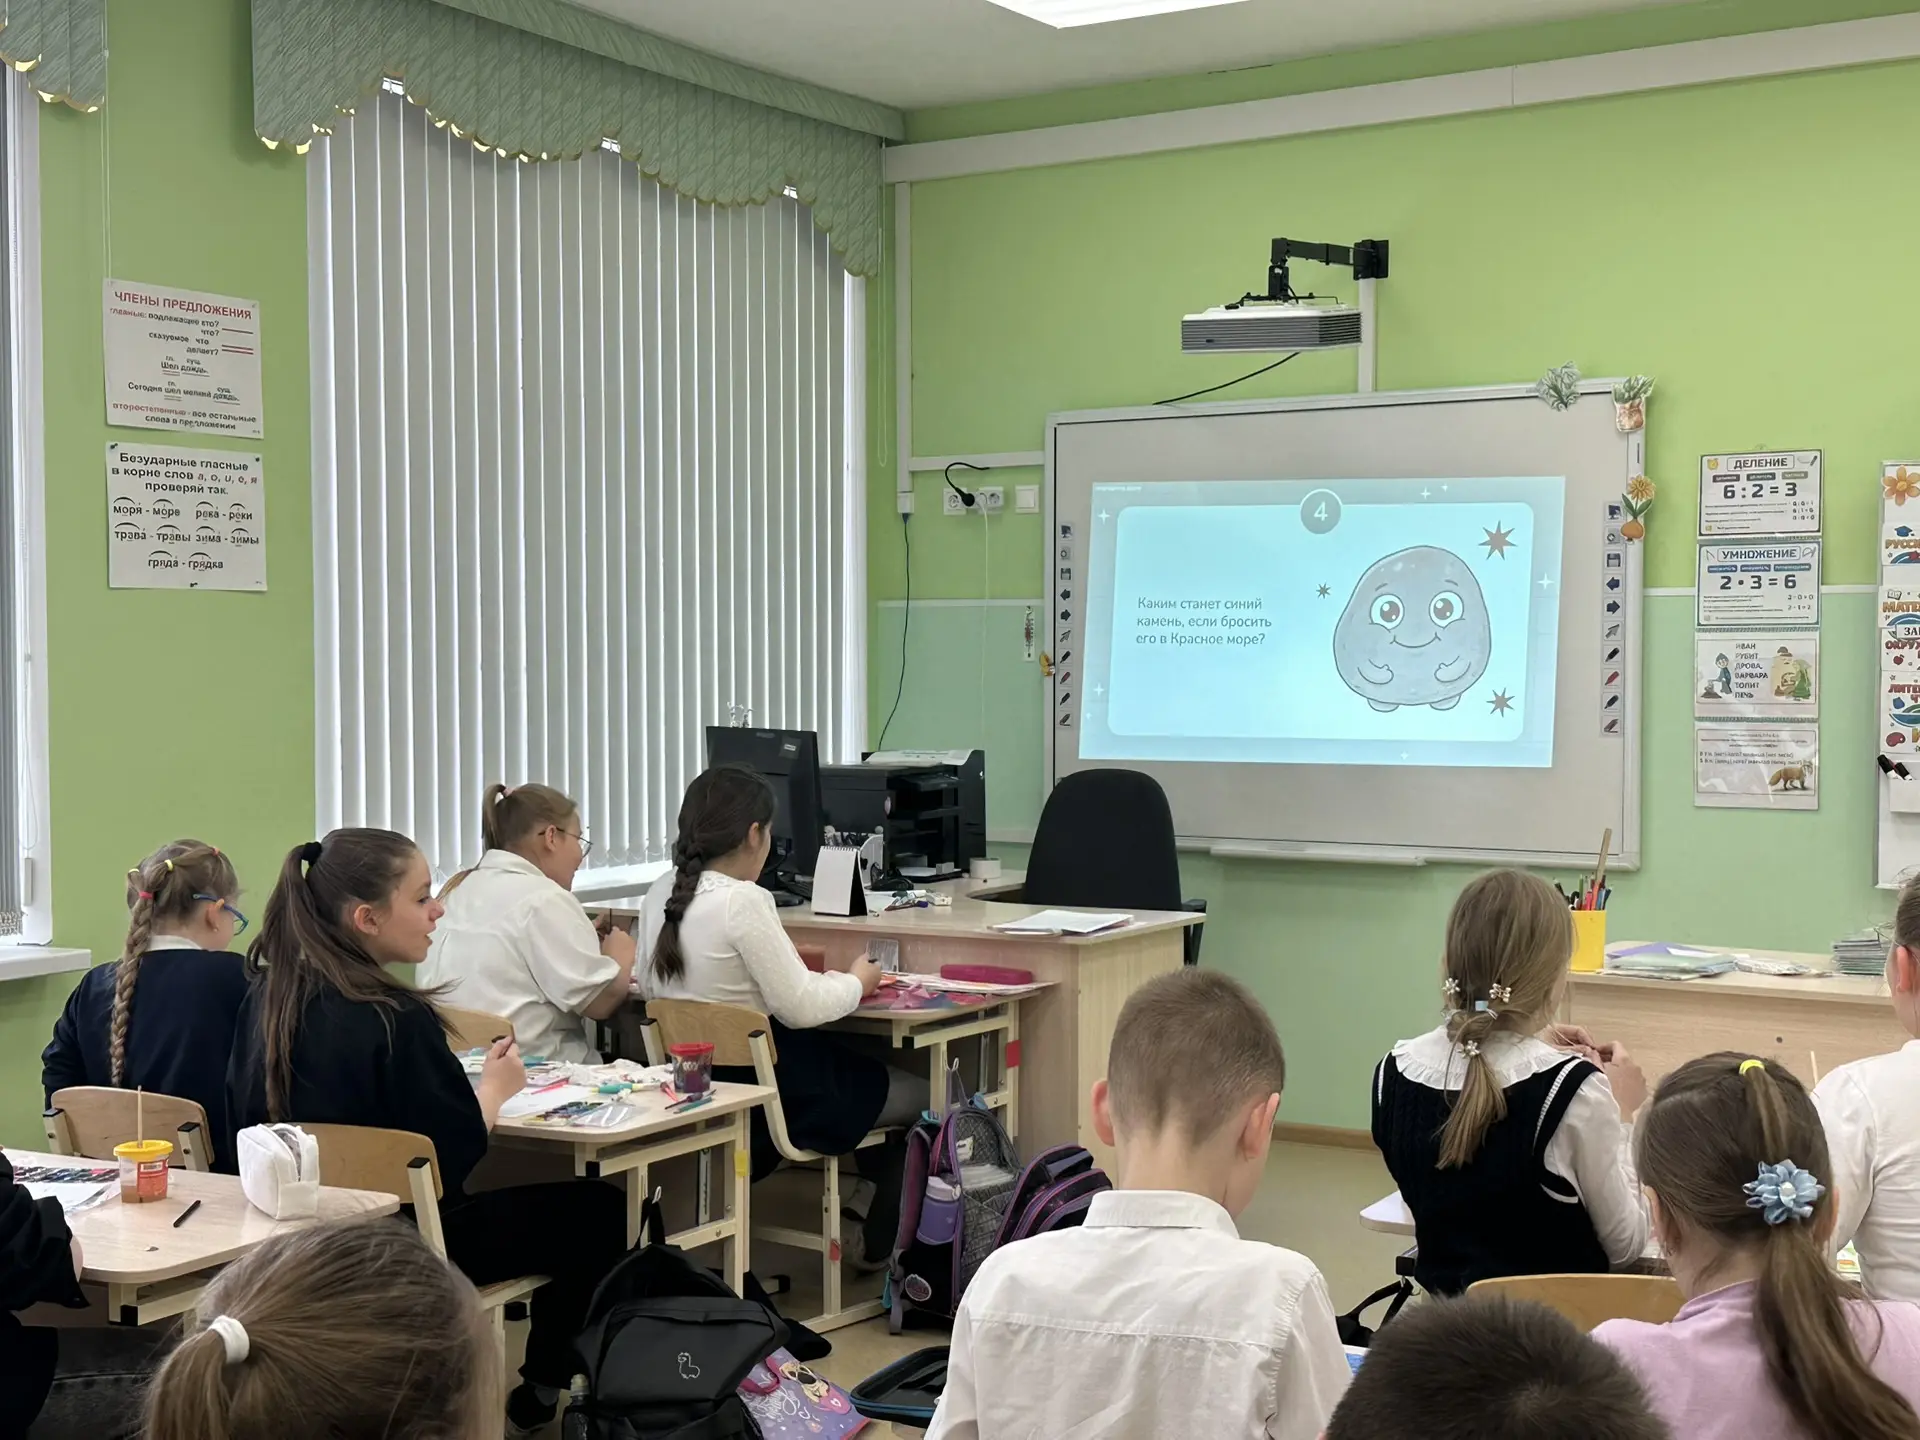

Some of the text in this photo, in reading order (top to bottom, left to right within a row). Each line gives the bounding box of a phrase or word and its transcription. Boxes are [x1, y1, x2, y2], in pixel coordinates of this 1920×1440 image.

[115, 291, 252, 319] ЧЛЕНЫ ПРЕДЛОЖЕНИЯ
[128, 381, 163, 393] Сегодня
[120, 453, 248, 471] Безударные гласные
[1734, 458, 1788, 469] ДЕЛЕНИЕ
[112, 467, 119, 475] в
[124, 467, 160, 479] корне
[164, 470, 194, 480] слов
[145, 482, 228, 495] проверяй так.
[1723, 484, 1736, 499] 6
[1752, 483, 1763, 498] 2
[1785, 482, 1797, 497] 3
[152, 506, 181, 518] море
[1314, 502, 1328, 521] 4
[157, 531, 191, 543] травы
[230, 534, 259, 545] зимы
[1722, 549, 1797, 560] УМНОЖЕНИЕ
[188, 558, 223, 570] грядка
[1720, 575, 1732, 590] 2
[1750, 575, 1762, 589] 3
[1784, 574, 1796, 589] 6
[1138, 597, 1262, 610] Каким станет синий
[1882, 601, 1920, 613] МАТЕ
[1137, 615, 1272, 629] камень, если бросить
[1904, 627, 1920, 636] ЗА
[1136, 632, 1265, 647] его в Красное море?
